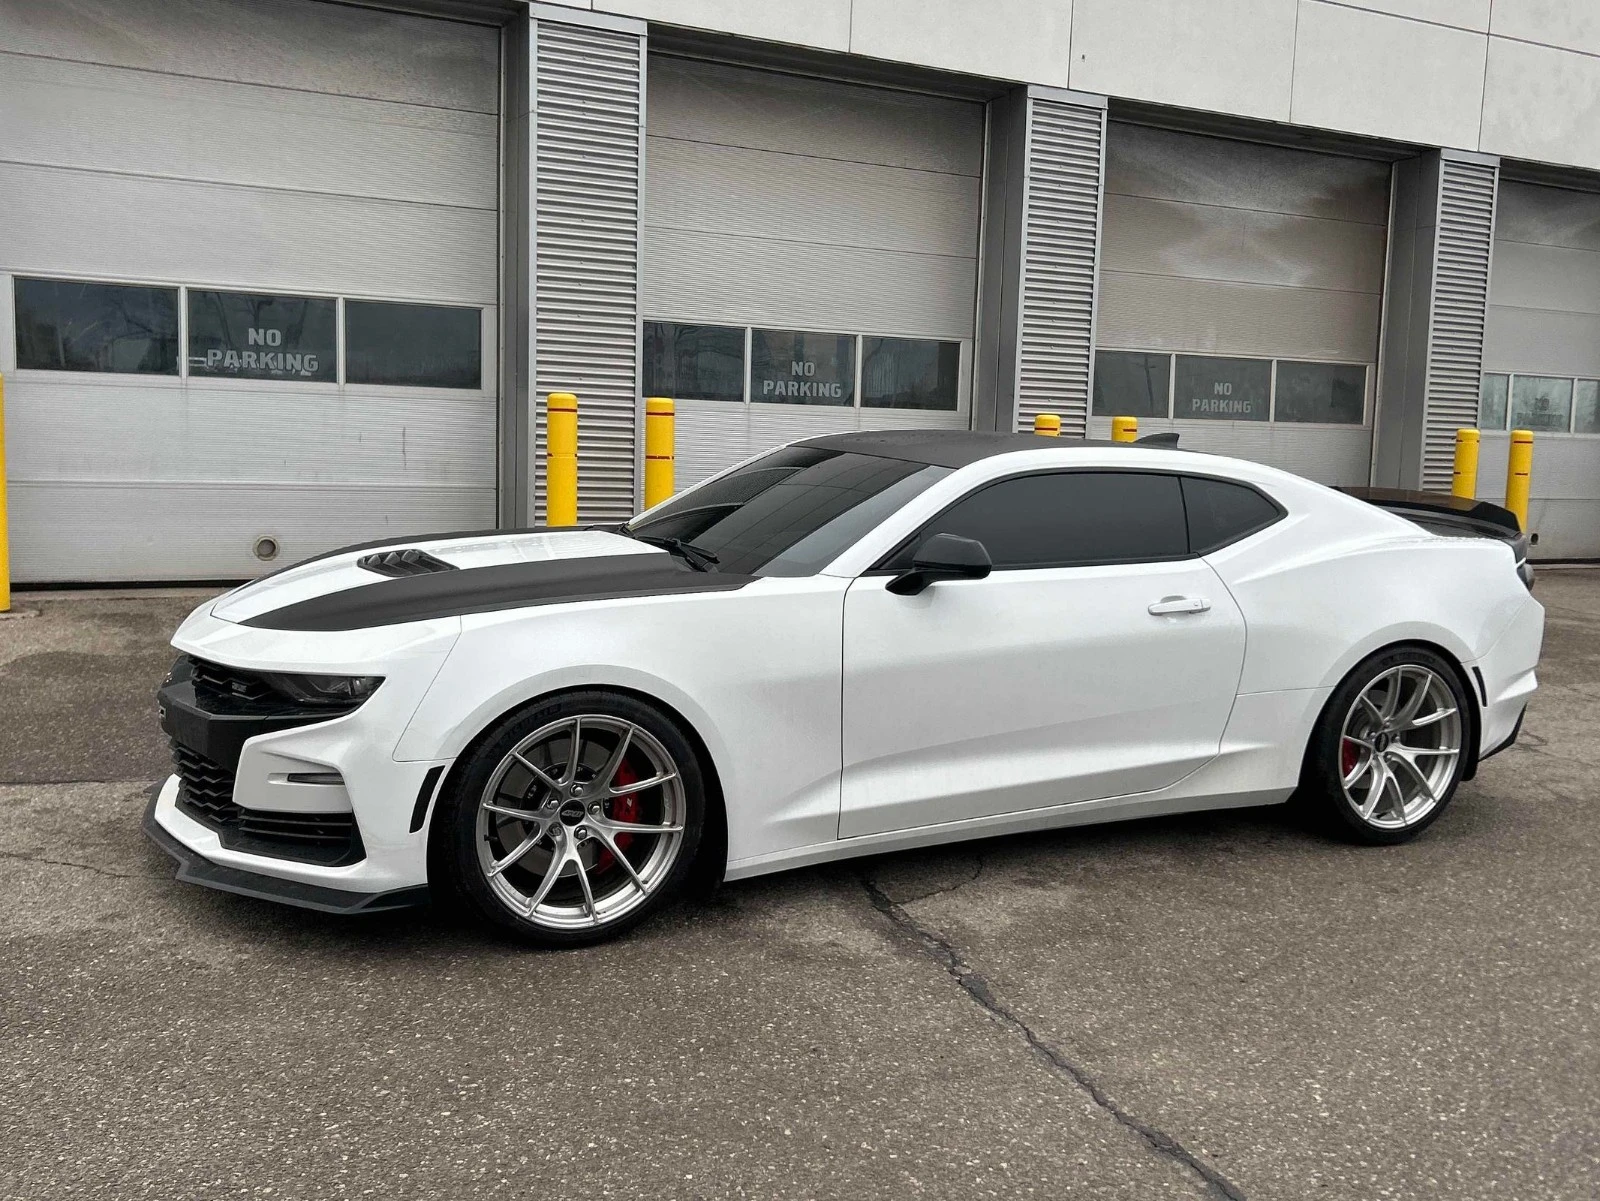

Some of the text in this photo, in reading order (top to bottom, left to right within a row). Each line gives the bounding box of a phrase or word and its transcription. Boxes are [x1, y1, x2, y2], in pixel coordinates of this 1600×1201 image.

[248, 327, 282, 347] NO
[207, 349, 319, 372] PARKING
[791, 361, 815, 377] NO
[763, 380, 842, 398] PARKING
[1214, 382, 1232, 396] NO
[1192, 398, 1251, 413] PARKING
